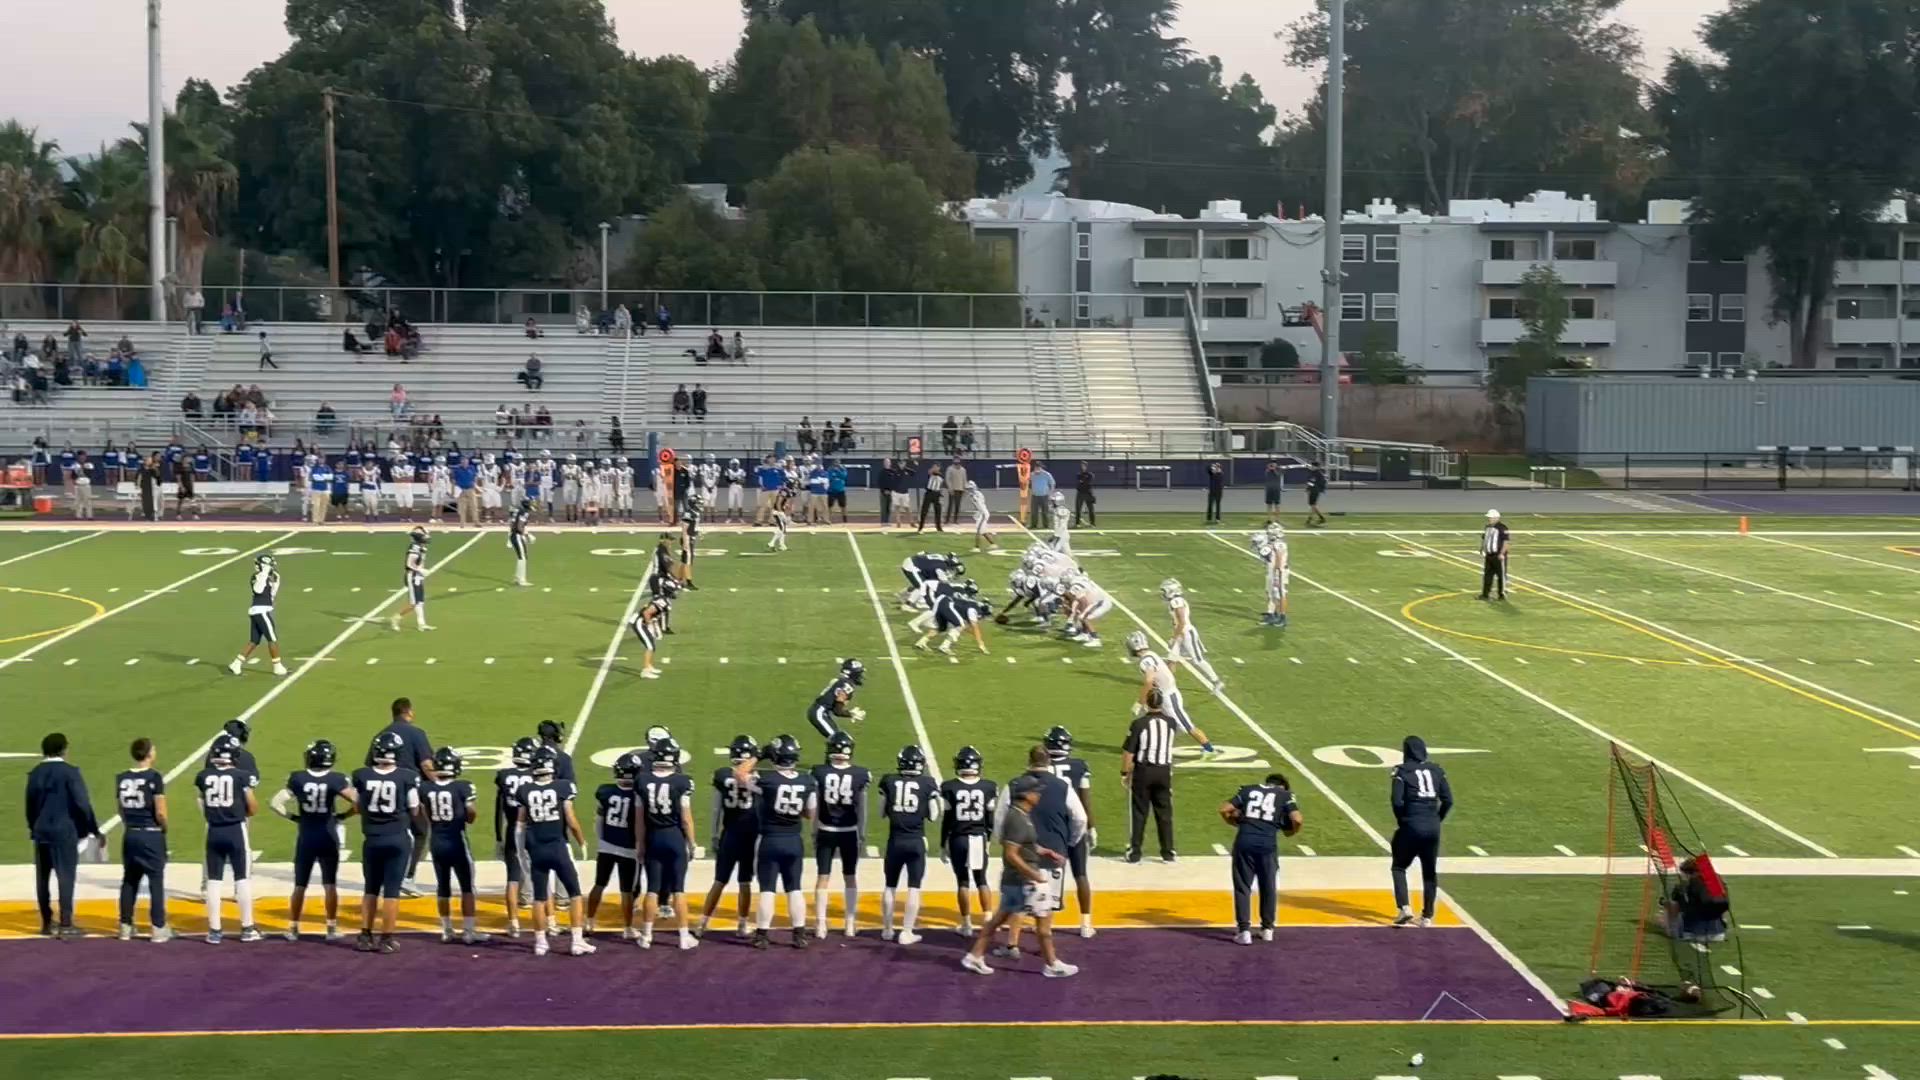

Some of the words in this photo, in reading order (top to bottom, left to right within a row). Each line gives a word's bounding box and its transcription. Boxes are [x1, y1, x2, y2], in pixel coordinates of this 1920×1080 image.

[119, 778, 146, 808] 25
[205, 775, 234, 807] 20
[302, 782, 328, 813] 31
[366, 780, 397, 813] 79
[646, 783, 672, 815] 14
[824, 773, 853, 805] 84
[893, 780, 920, 813] 16
[1415, 769, 1436, 798] 11
[427, 791, 454, 822] 18
[527, 789, 560, 822] 82
[606, 795, 631, 828] 21
[774, 784, 805, 816] 65
[956, 789, 984, 821] 23
[1245, 790, 1277, 822] 24
